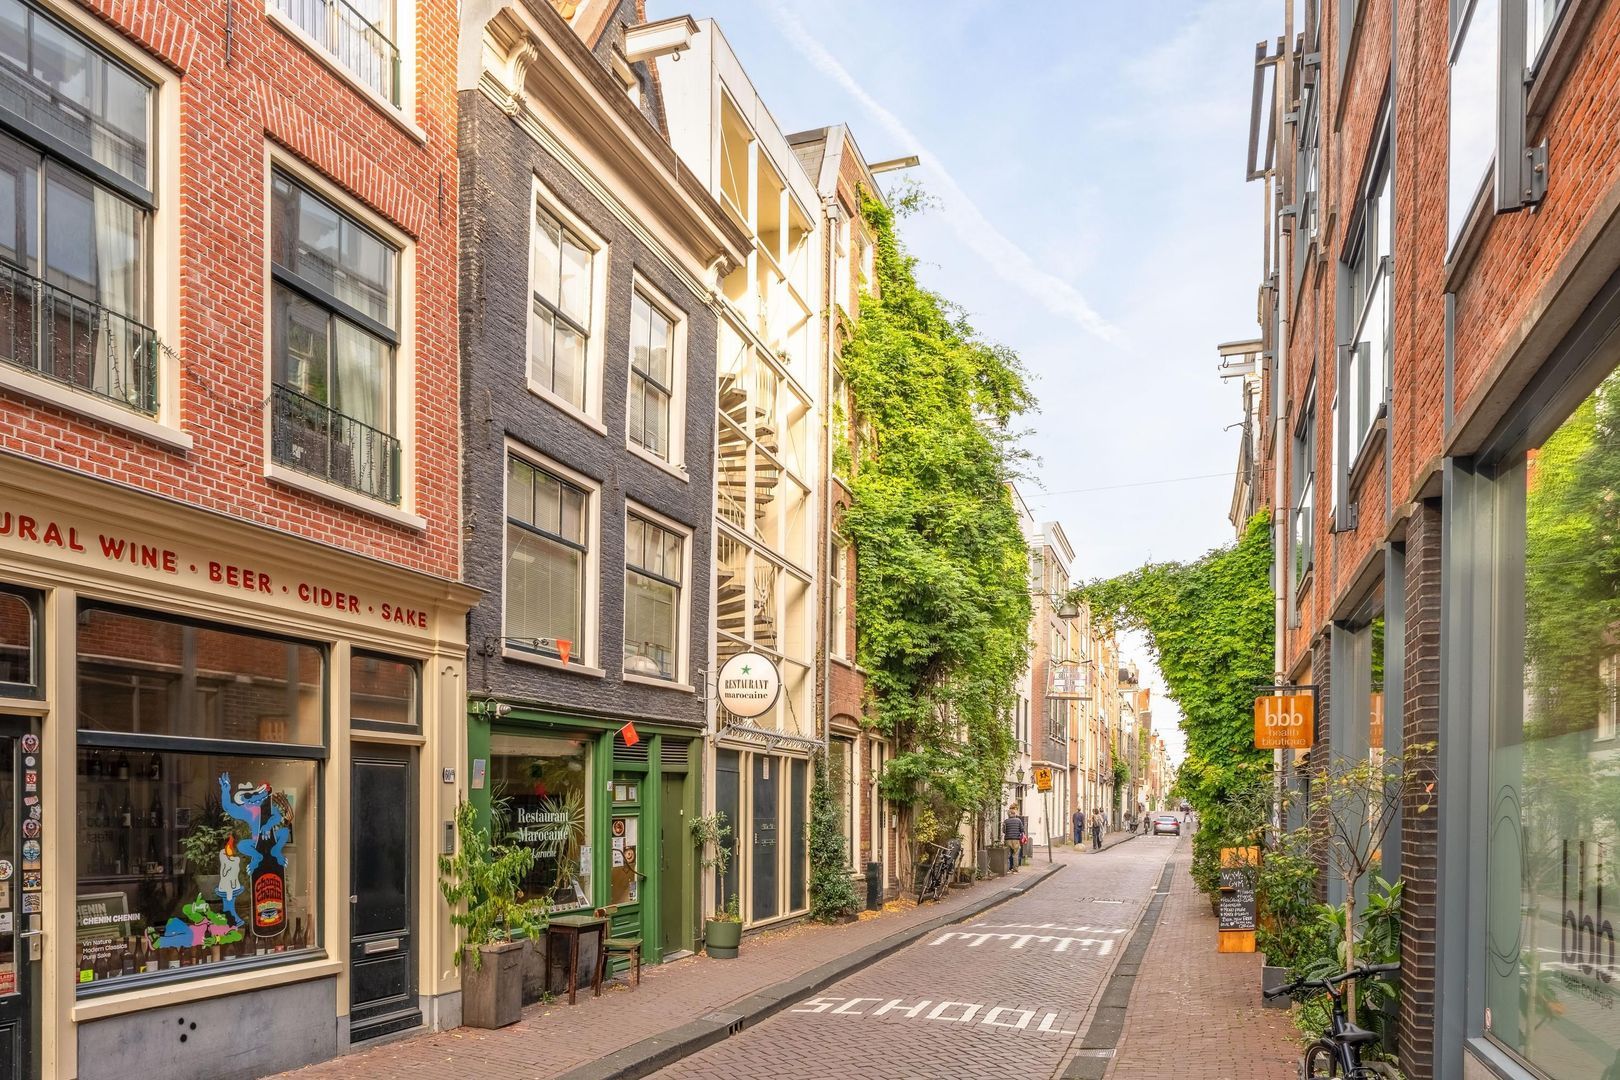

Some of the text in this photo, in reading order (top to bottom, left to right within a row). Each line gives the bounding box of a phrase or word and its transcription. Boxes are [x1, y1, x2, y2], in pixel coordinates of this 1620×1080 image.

[99, 534, 177, 573] WINE
[208, 561, 272, 594] BEER
[298, 583, 360, 614] CIDER
[381, 603, 428, 629] SAKE
[725, 680, 768, 690] RESTAURANT
[725, 691, 768, 699] marocaine
[1265, 698, 1303, 727] bbb
[1269, 728, 1299, 737] health
[1262, 738, 1306, 747] boutique
[517, 808, 569, 823] Restaurant
[518, 827, 569, 842] Marocaine
[83, 916, 112, 926] CHENIN
[112, 913, 141, 923] CHENIN
[105, 943, 128, 951] Classics
[791, 997, 1077, 1035] SCHOOL
